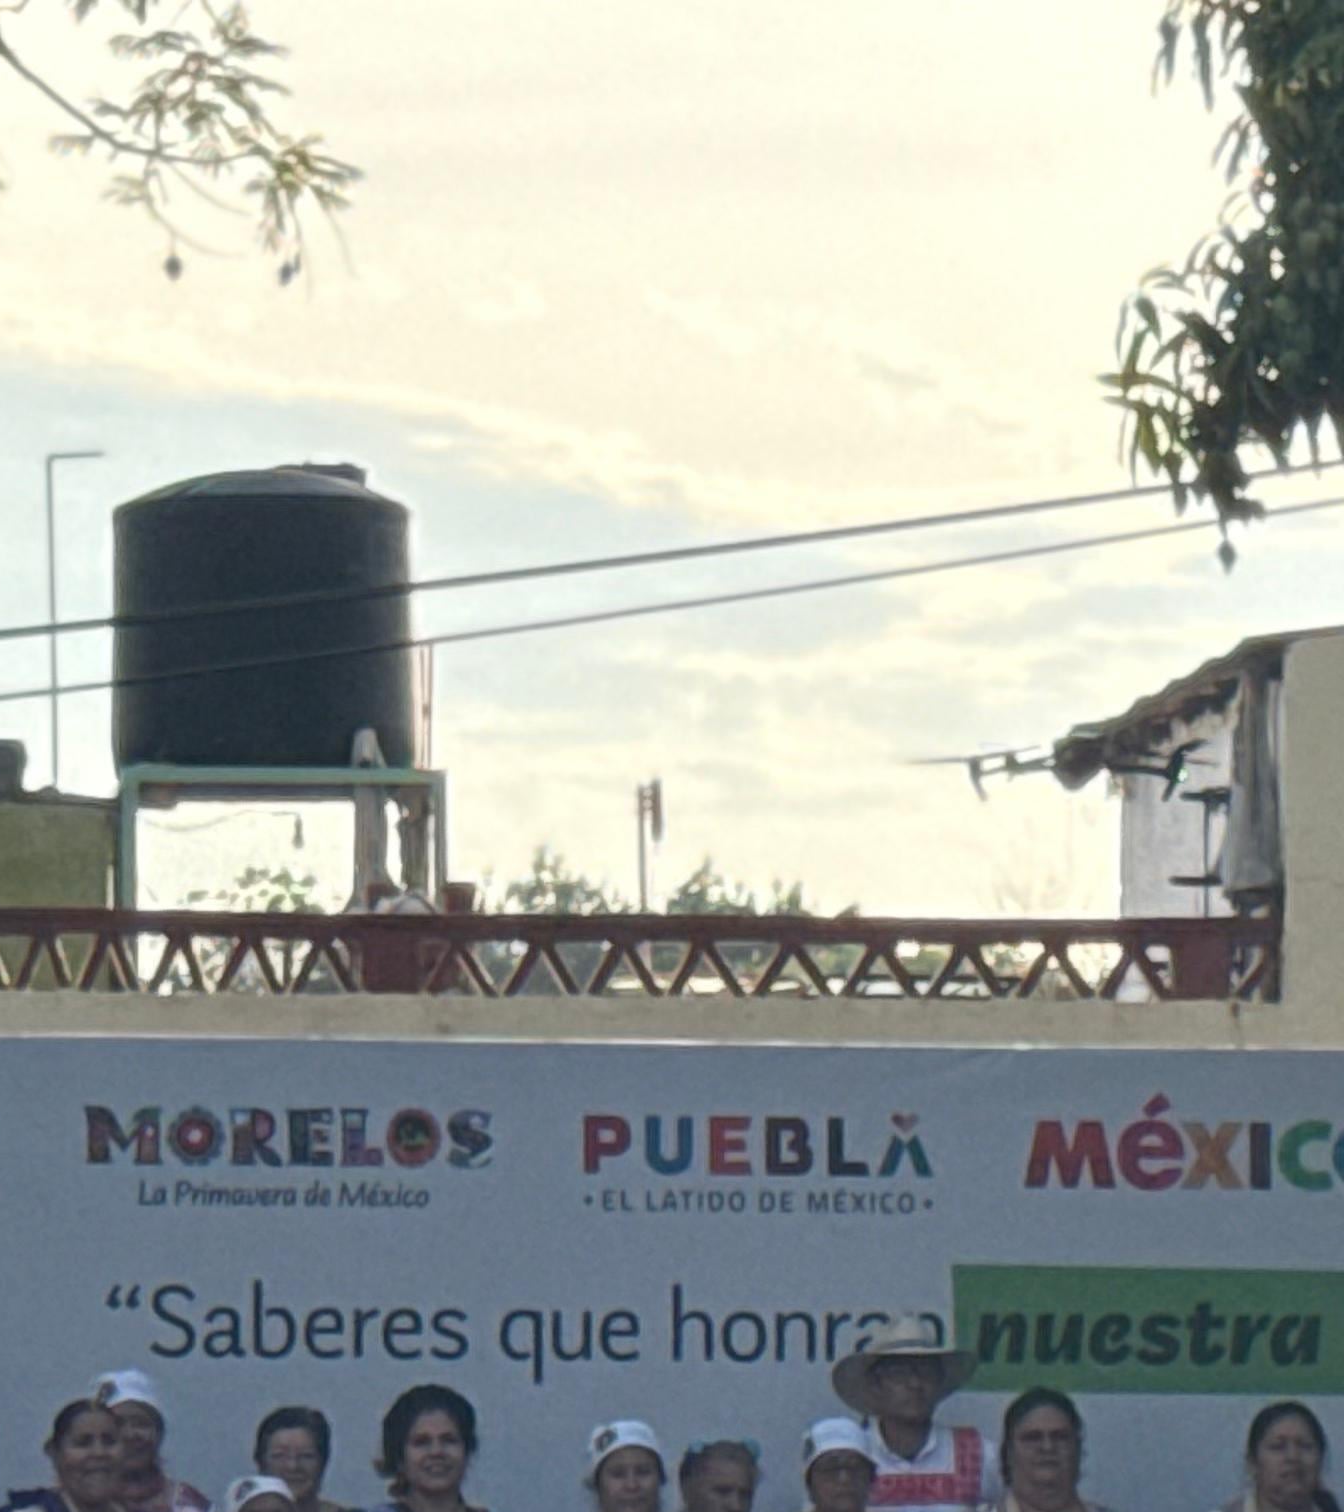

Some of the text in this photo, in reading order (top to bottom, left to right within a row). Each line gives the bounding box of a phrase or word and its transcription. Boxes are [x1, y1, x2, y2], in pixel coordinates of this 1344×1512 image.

[84, 1104, 494, 1170] MORELOS
[582, 1113, 934, 1178] PUEBLA
[138, 1180, 431, 1209] La Primavera de México
[601, 1186, 917, 1215] EL LATIDO DE MÉXICO
[498, 1307, 641, 1386] que
[976, 1301, 1323, 1366] nuestra
